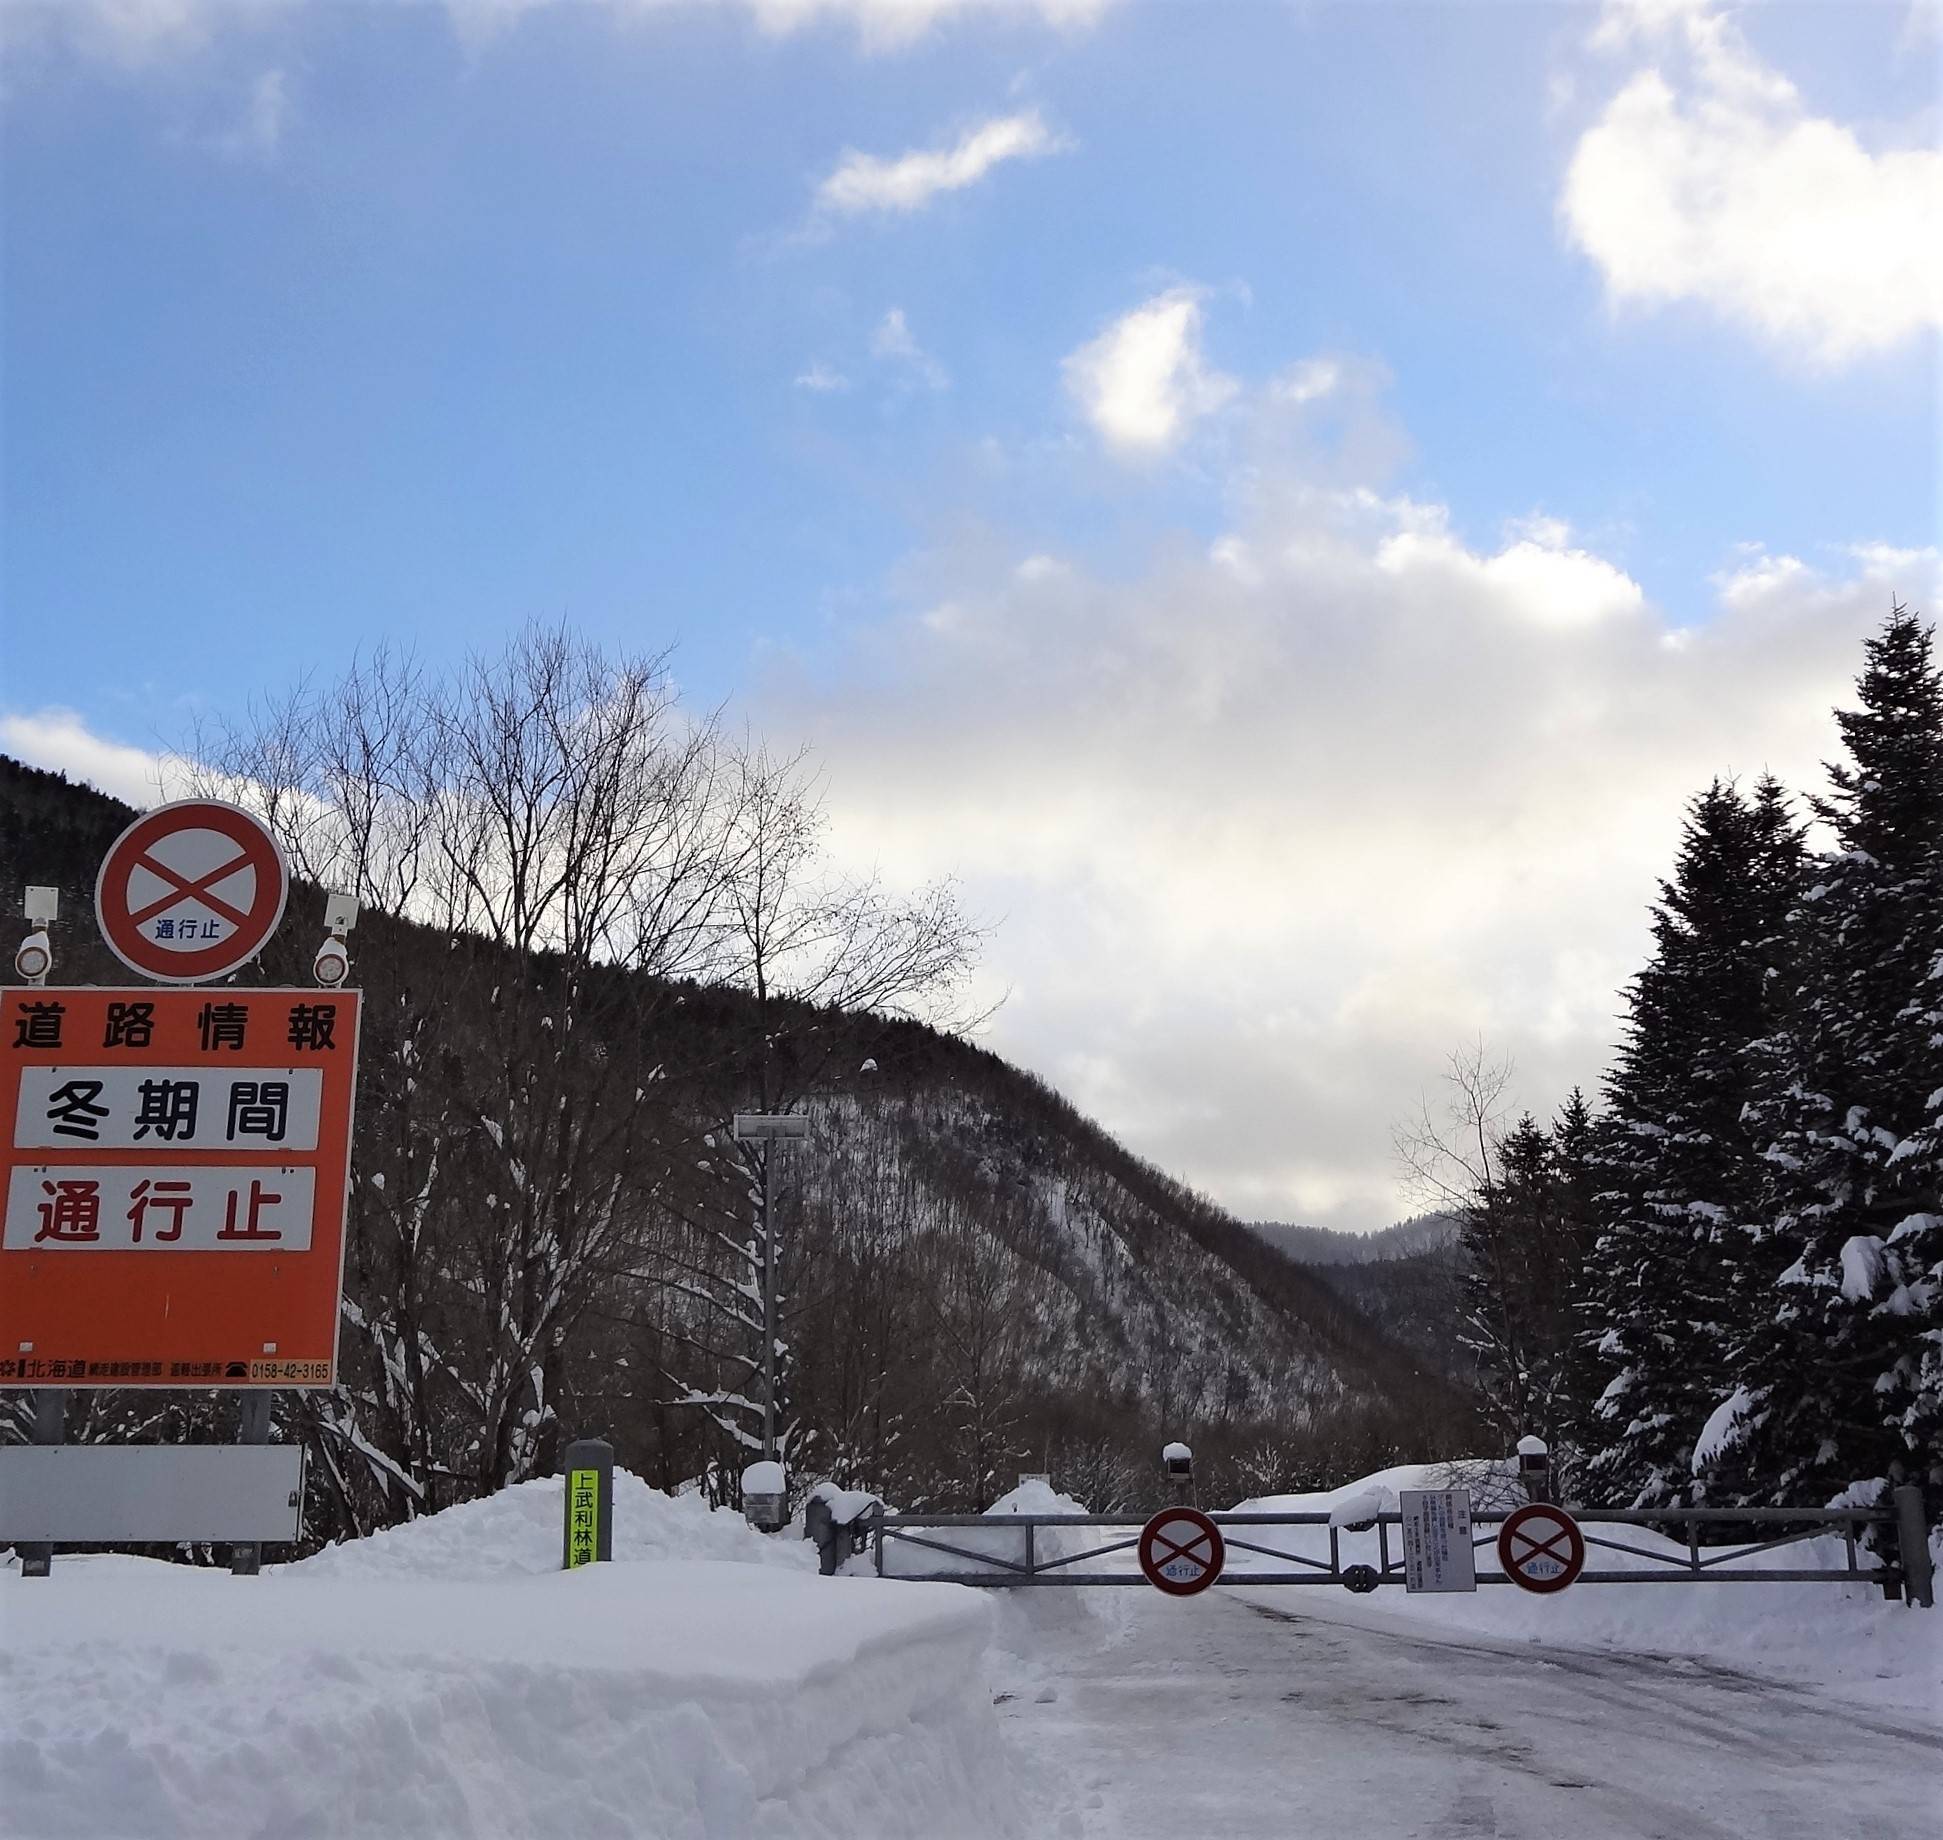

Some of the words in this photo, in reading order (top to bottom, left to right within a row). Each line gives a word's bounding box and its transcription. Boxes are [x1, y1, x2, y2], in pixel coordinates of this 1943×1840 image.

[155, 919, 220, 939] 通行止
[12, 1002, 337, 1050] 道路情報
[47, 1079, 289, 1141] 冬期間
[34, 1179, 283, 1243] 通行止
[27, 1360, 87, 1377] 北海道
[252, 1363, 329, 1379] 0158-42-3165
[574, 1473, 594, 1565] 上武利林道
[1166, 1564, 1200, 1577] 通行止
